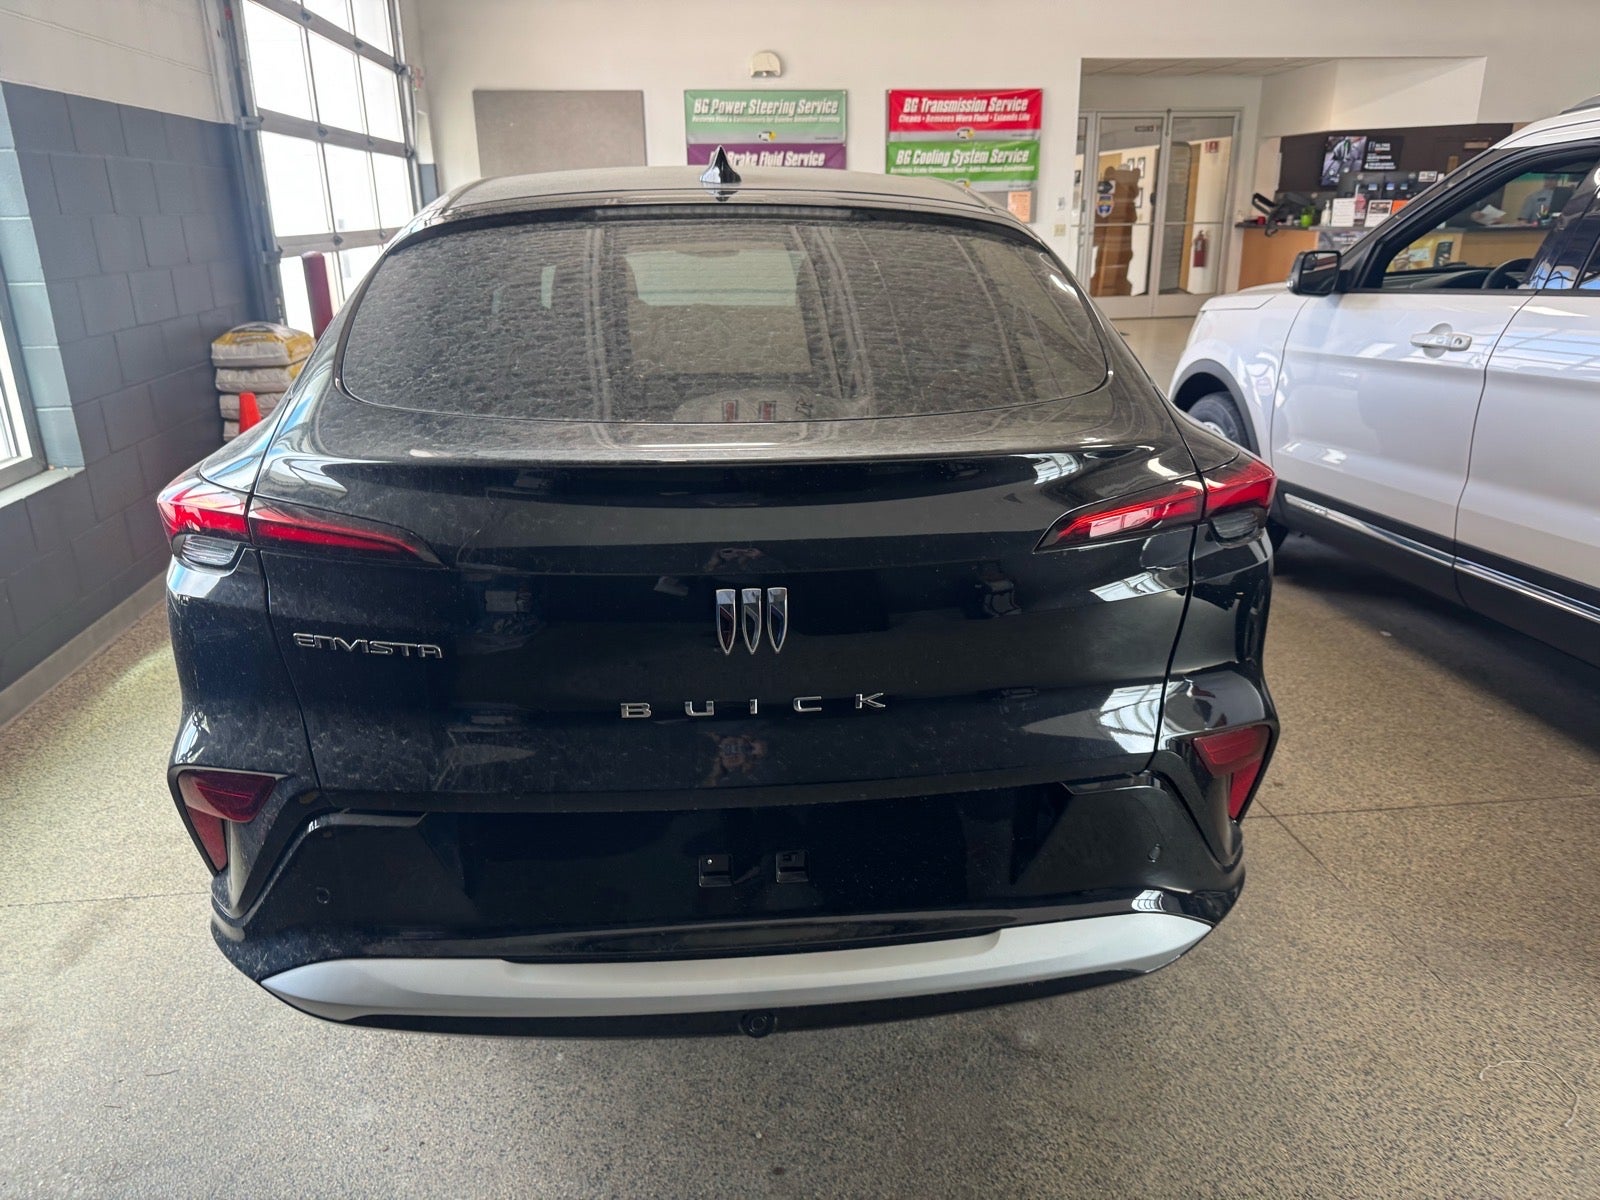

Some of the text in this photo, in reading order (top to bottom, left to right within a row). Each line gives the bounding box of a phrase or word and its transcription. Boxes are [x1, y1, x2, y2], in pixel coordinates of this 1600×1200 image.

[693, 98, 839, 117] BG Power Steering Service
[903, 96, 1029, 113] BG Transmission Service
[727, 151, 758, 167] Brake
[758, 151, 785, 167] Fluid
[785, 151, 826, 167] Service
[896, 148, 1029, 167] BG Cooling System Service
[293, 632, 443, 659] ENVISTA
[620, 692, 887, 718] BUICK
